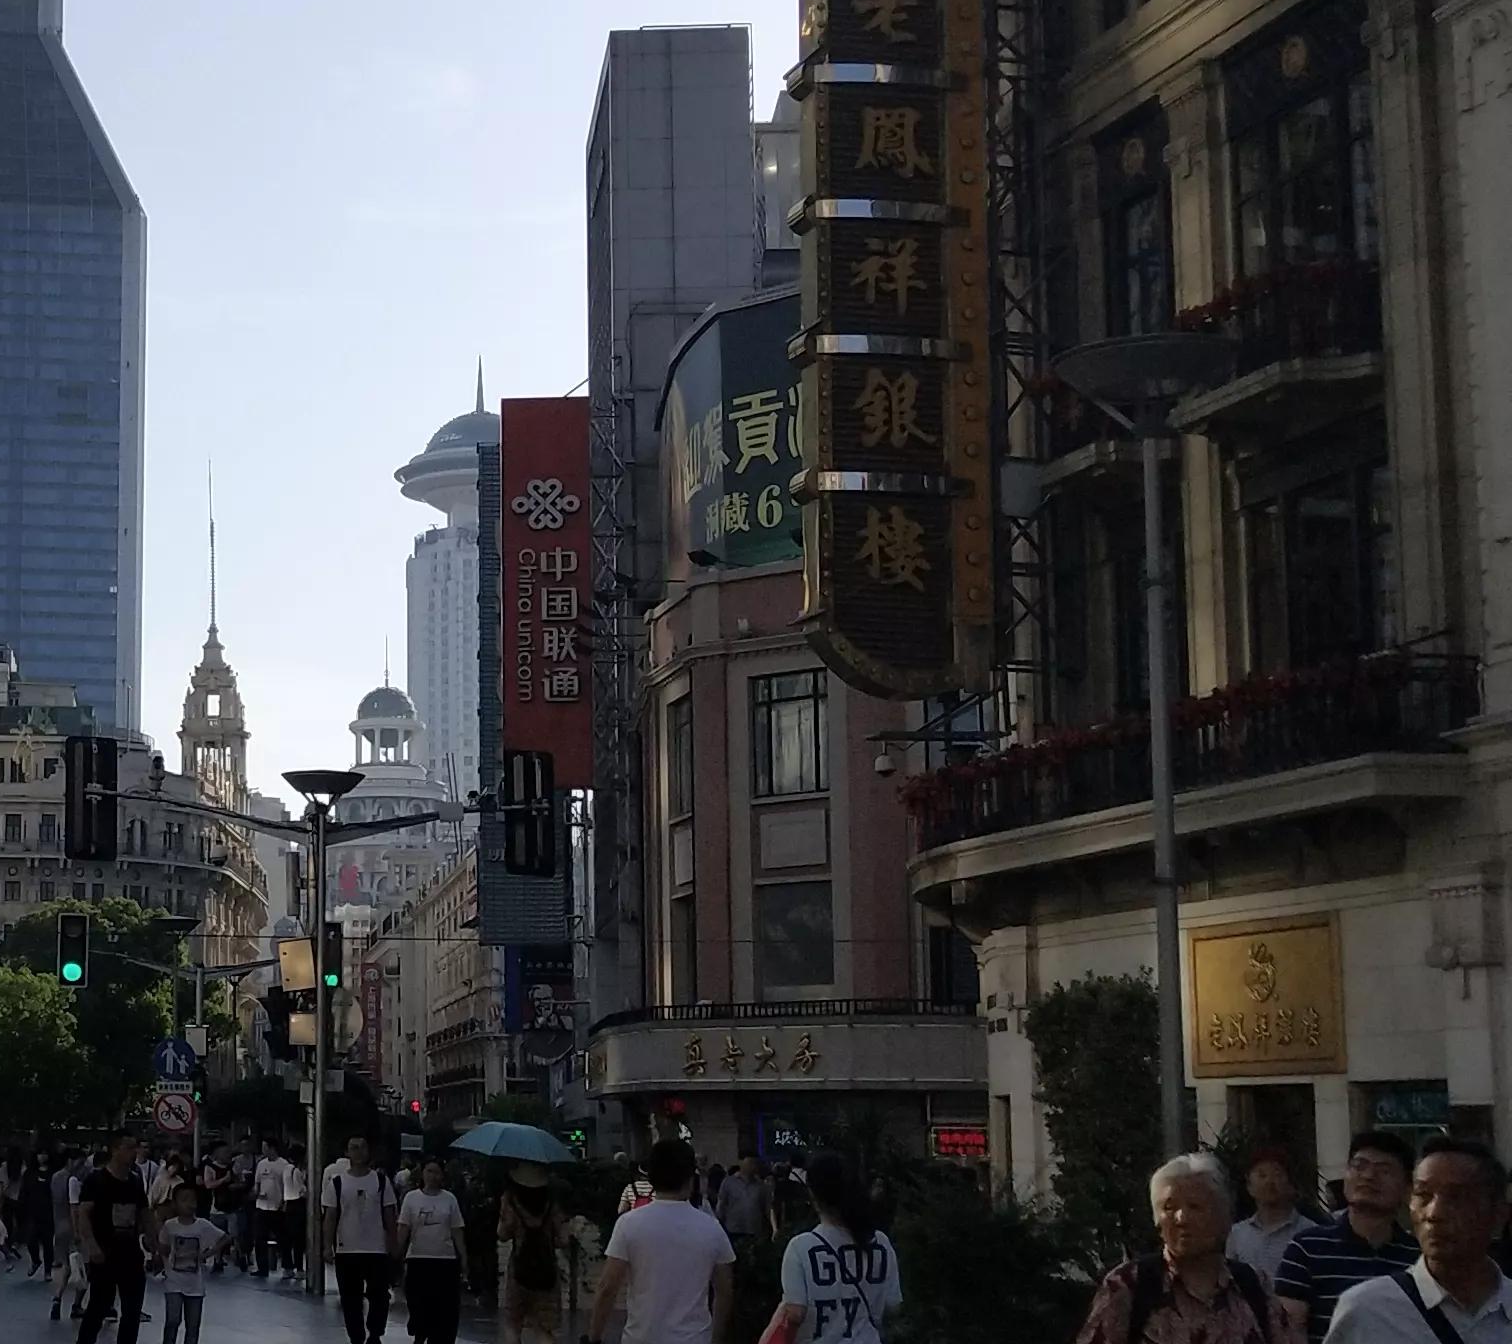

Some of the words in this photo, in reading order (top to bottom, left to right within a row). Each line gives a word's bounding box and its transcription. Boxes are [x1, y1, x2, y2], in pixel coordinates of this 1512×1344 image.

[517, 547, 537, 610] China
[540, 546, 580, 703] 中国联通
[517, 621, 535, 703] unicom
[813, 1297, 861, 1340] FY
